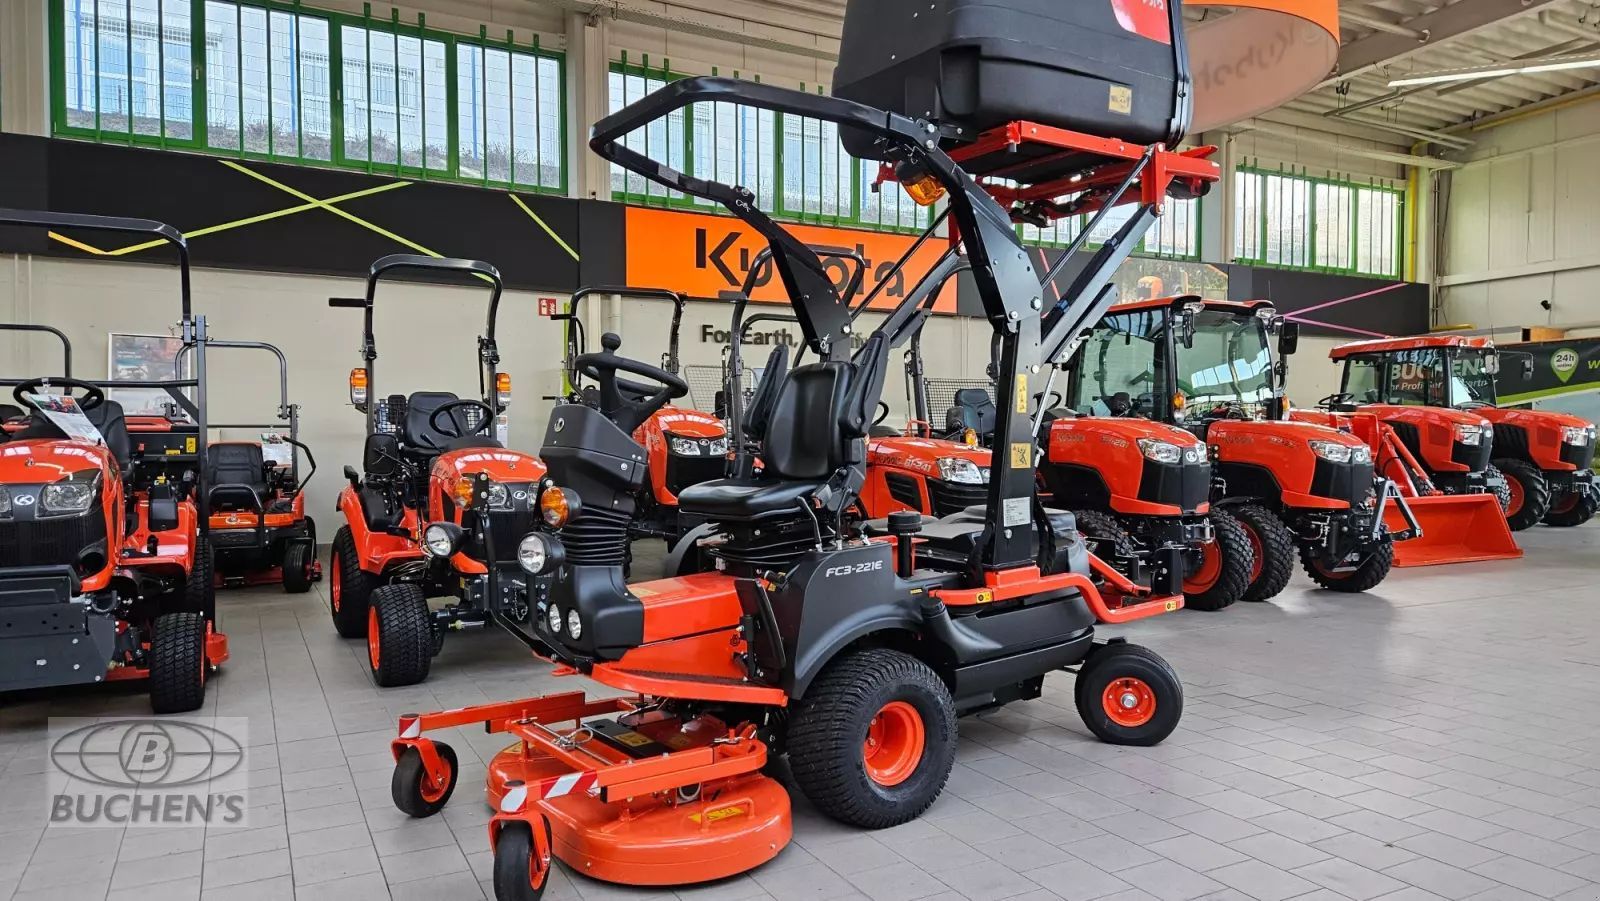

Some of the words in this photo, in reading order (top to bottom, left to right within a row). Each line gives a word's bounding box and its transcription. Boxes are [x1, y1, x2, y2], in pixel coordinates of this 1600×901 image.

[695, 227, 905, 298] Kuota
[1556, 353, 1574, 362] 24h
[825, 560, 883, 578] FC3-221E
